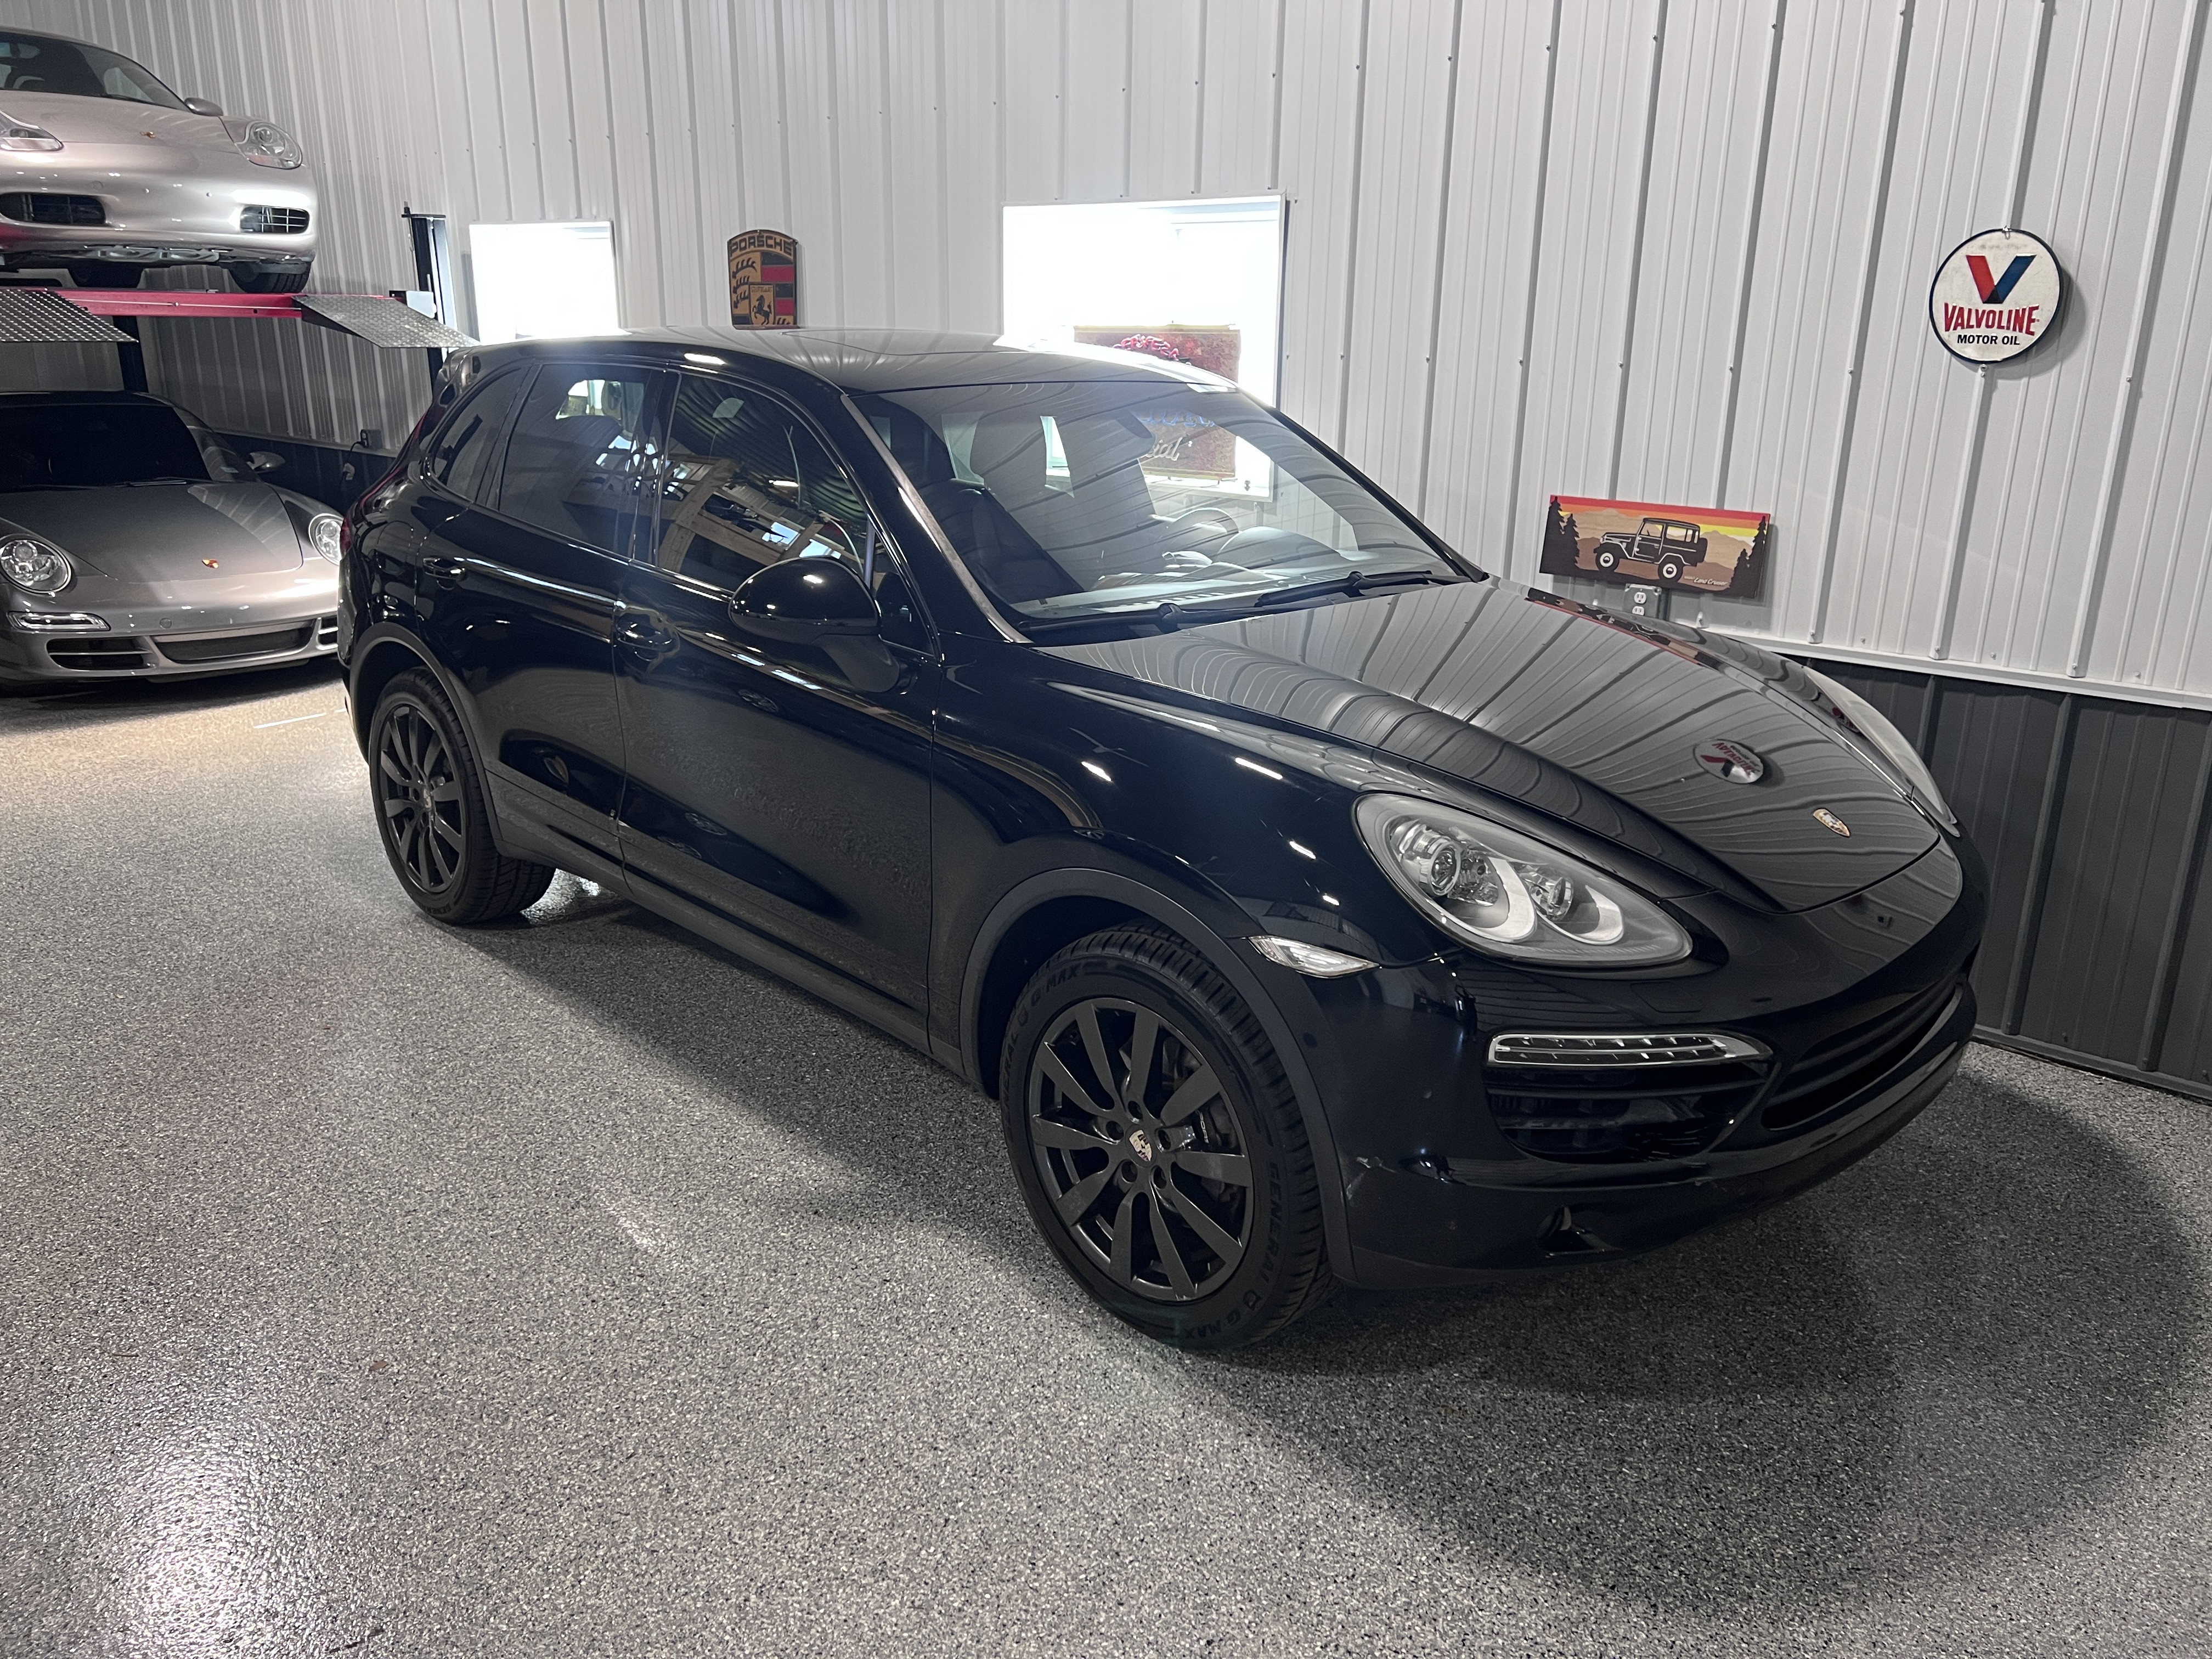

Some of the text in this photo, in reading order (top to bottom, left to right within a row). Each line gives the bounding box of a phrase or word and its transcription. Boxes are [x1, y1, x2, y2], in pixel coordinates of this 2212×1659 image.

[730, 235, 793, 257] PORSCHE
[1944, 302, 2039, 336] VALVOLINE
[1957, 334, 2020, 345] MOTOR OIL
